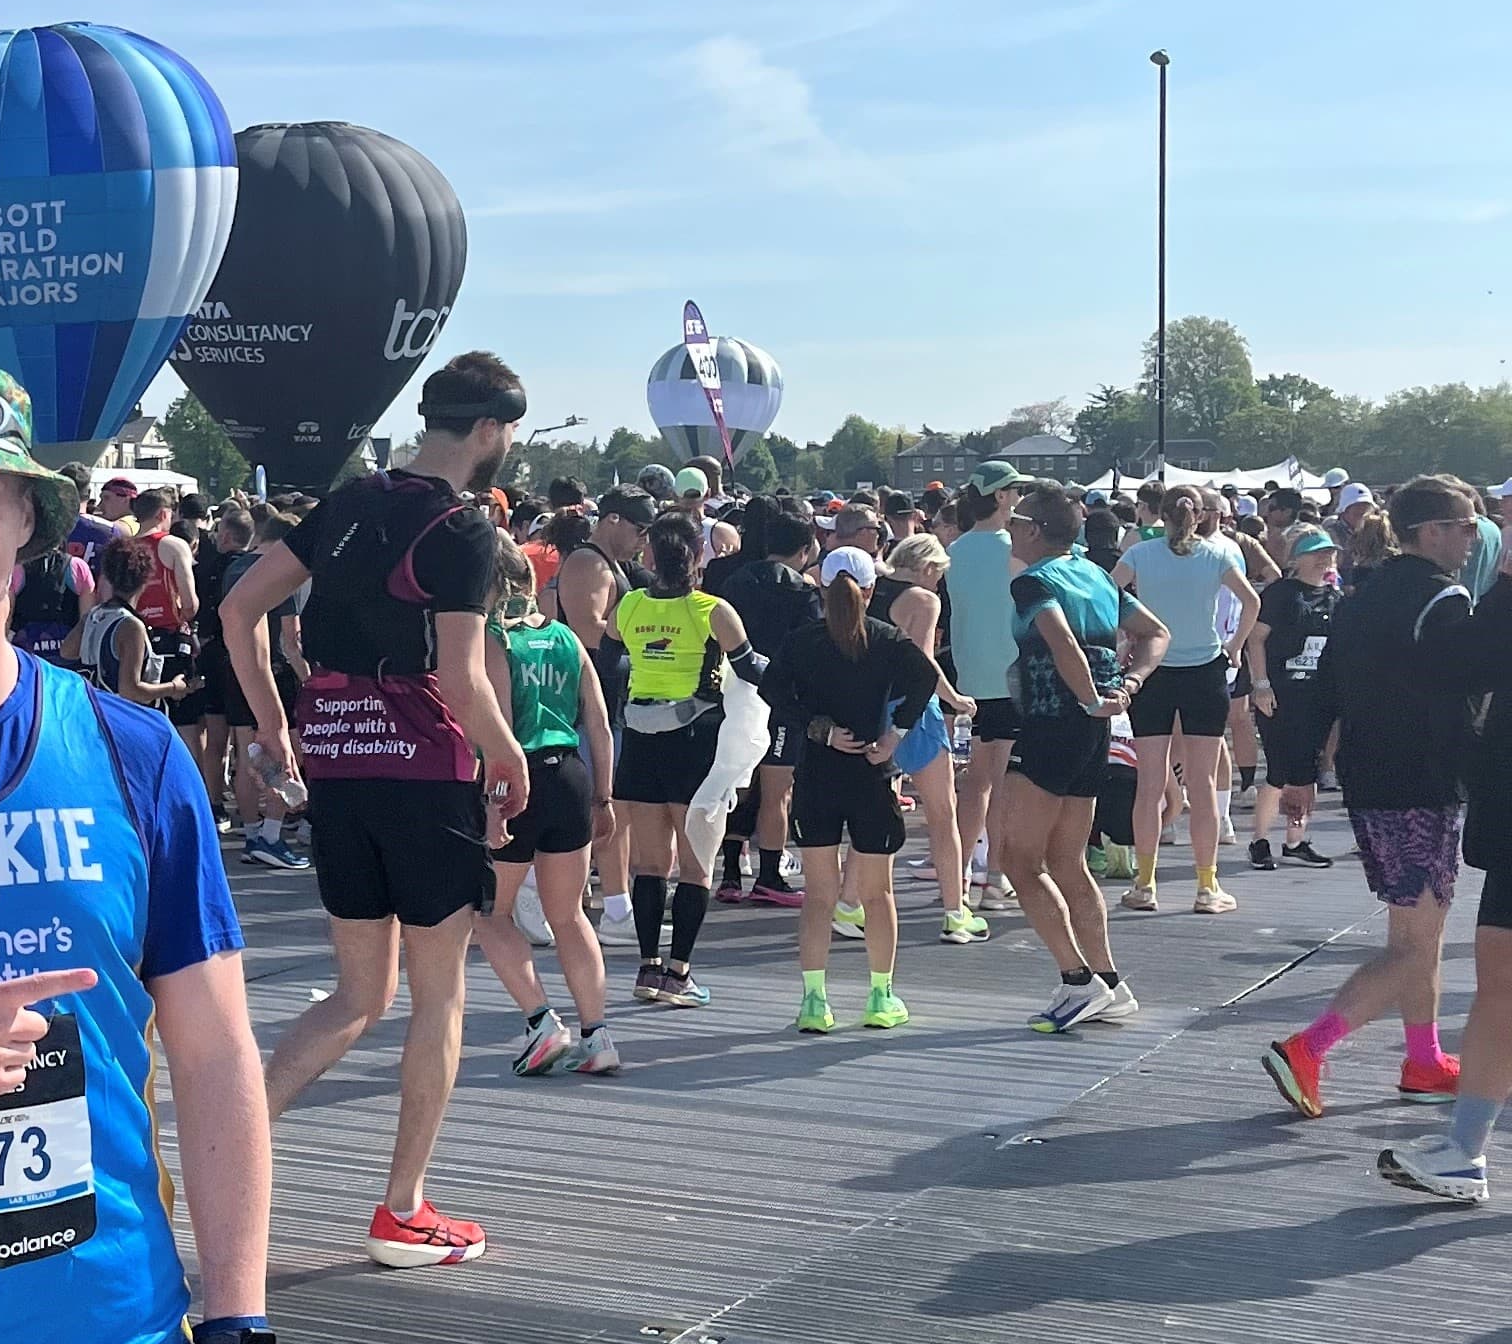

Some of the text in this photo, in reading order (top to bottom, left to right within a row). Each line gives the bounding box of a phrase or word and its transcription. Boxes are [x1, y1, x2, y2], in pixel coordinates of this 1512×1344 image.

[188, 324, 313, 343] CONSULTANCY
[194, 345, 265, 364] SERVICES
[520, 662, 569, 695] Klly
[302, 718, 351, 737] people
[354, 718, 386, 734] with
[342, 738, 417, 760] disability
